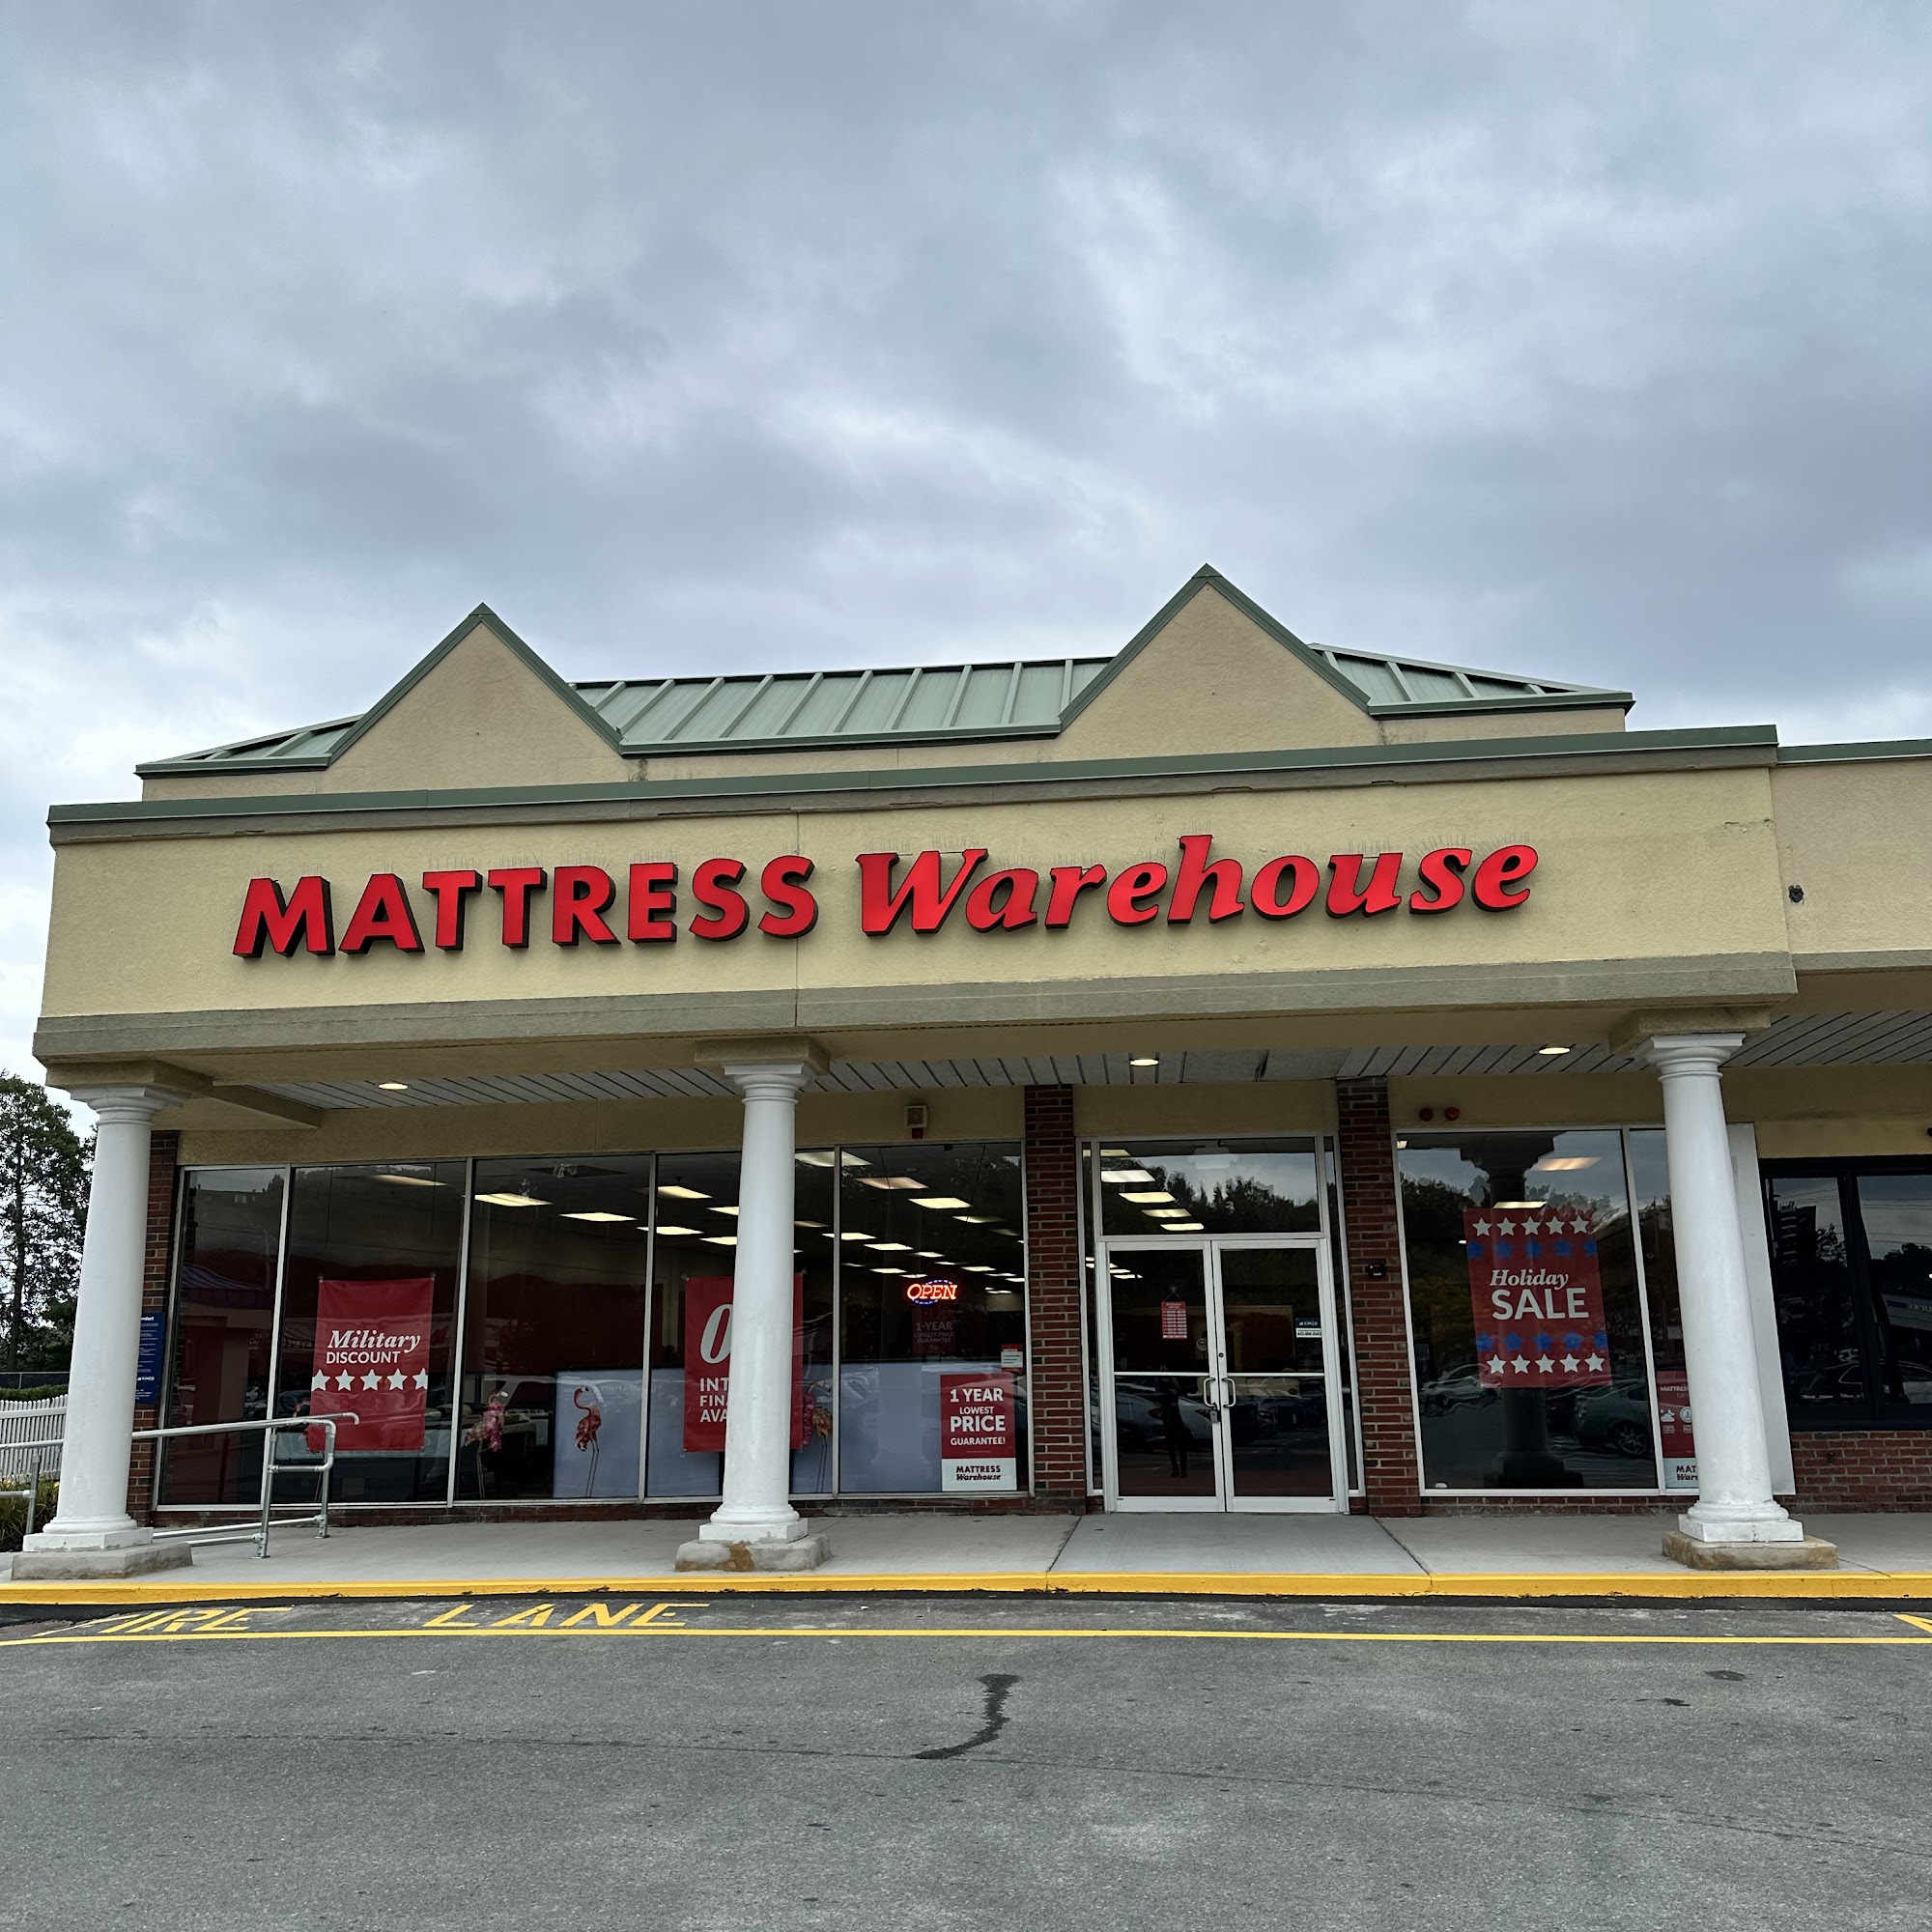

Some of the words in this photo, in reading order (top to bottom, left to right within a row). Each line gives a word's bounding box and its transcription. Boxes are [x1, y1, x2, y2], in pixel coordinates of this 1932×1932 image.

[233, 855, 818, 957] MATTRESS
[856, 835, 1540, 936] Warehouse
[1489, 1267, 1569, 1291] Holiday
[906, 1283, 958, 1300] OPEN
[1491, 1287, 1589, 1321] SALE
[915, 1321, 953, 1331] 1-YEAR
[327, 1329, 421, 1353] Military
[326, 1350, 401, 1364] DISCOUNT
[699, 1394, 728, 1407] FIN
[950, 1388, 959, 1403] 1
[962, 1387, 1004, 1403] YEAR
[959, 1406, 995, 1415] LOWEST
[950, 1414, 1007, 1433] PRICE
[950, 1436, 1006, 1446] GUARANTEE!
[955, 1464, 1001, 1473] MATTRESS
[422, 1603, 711, 1628] LANE
